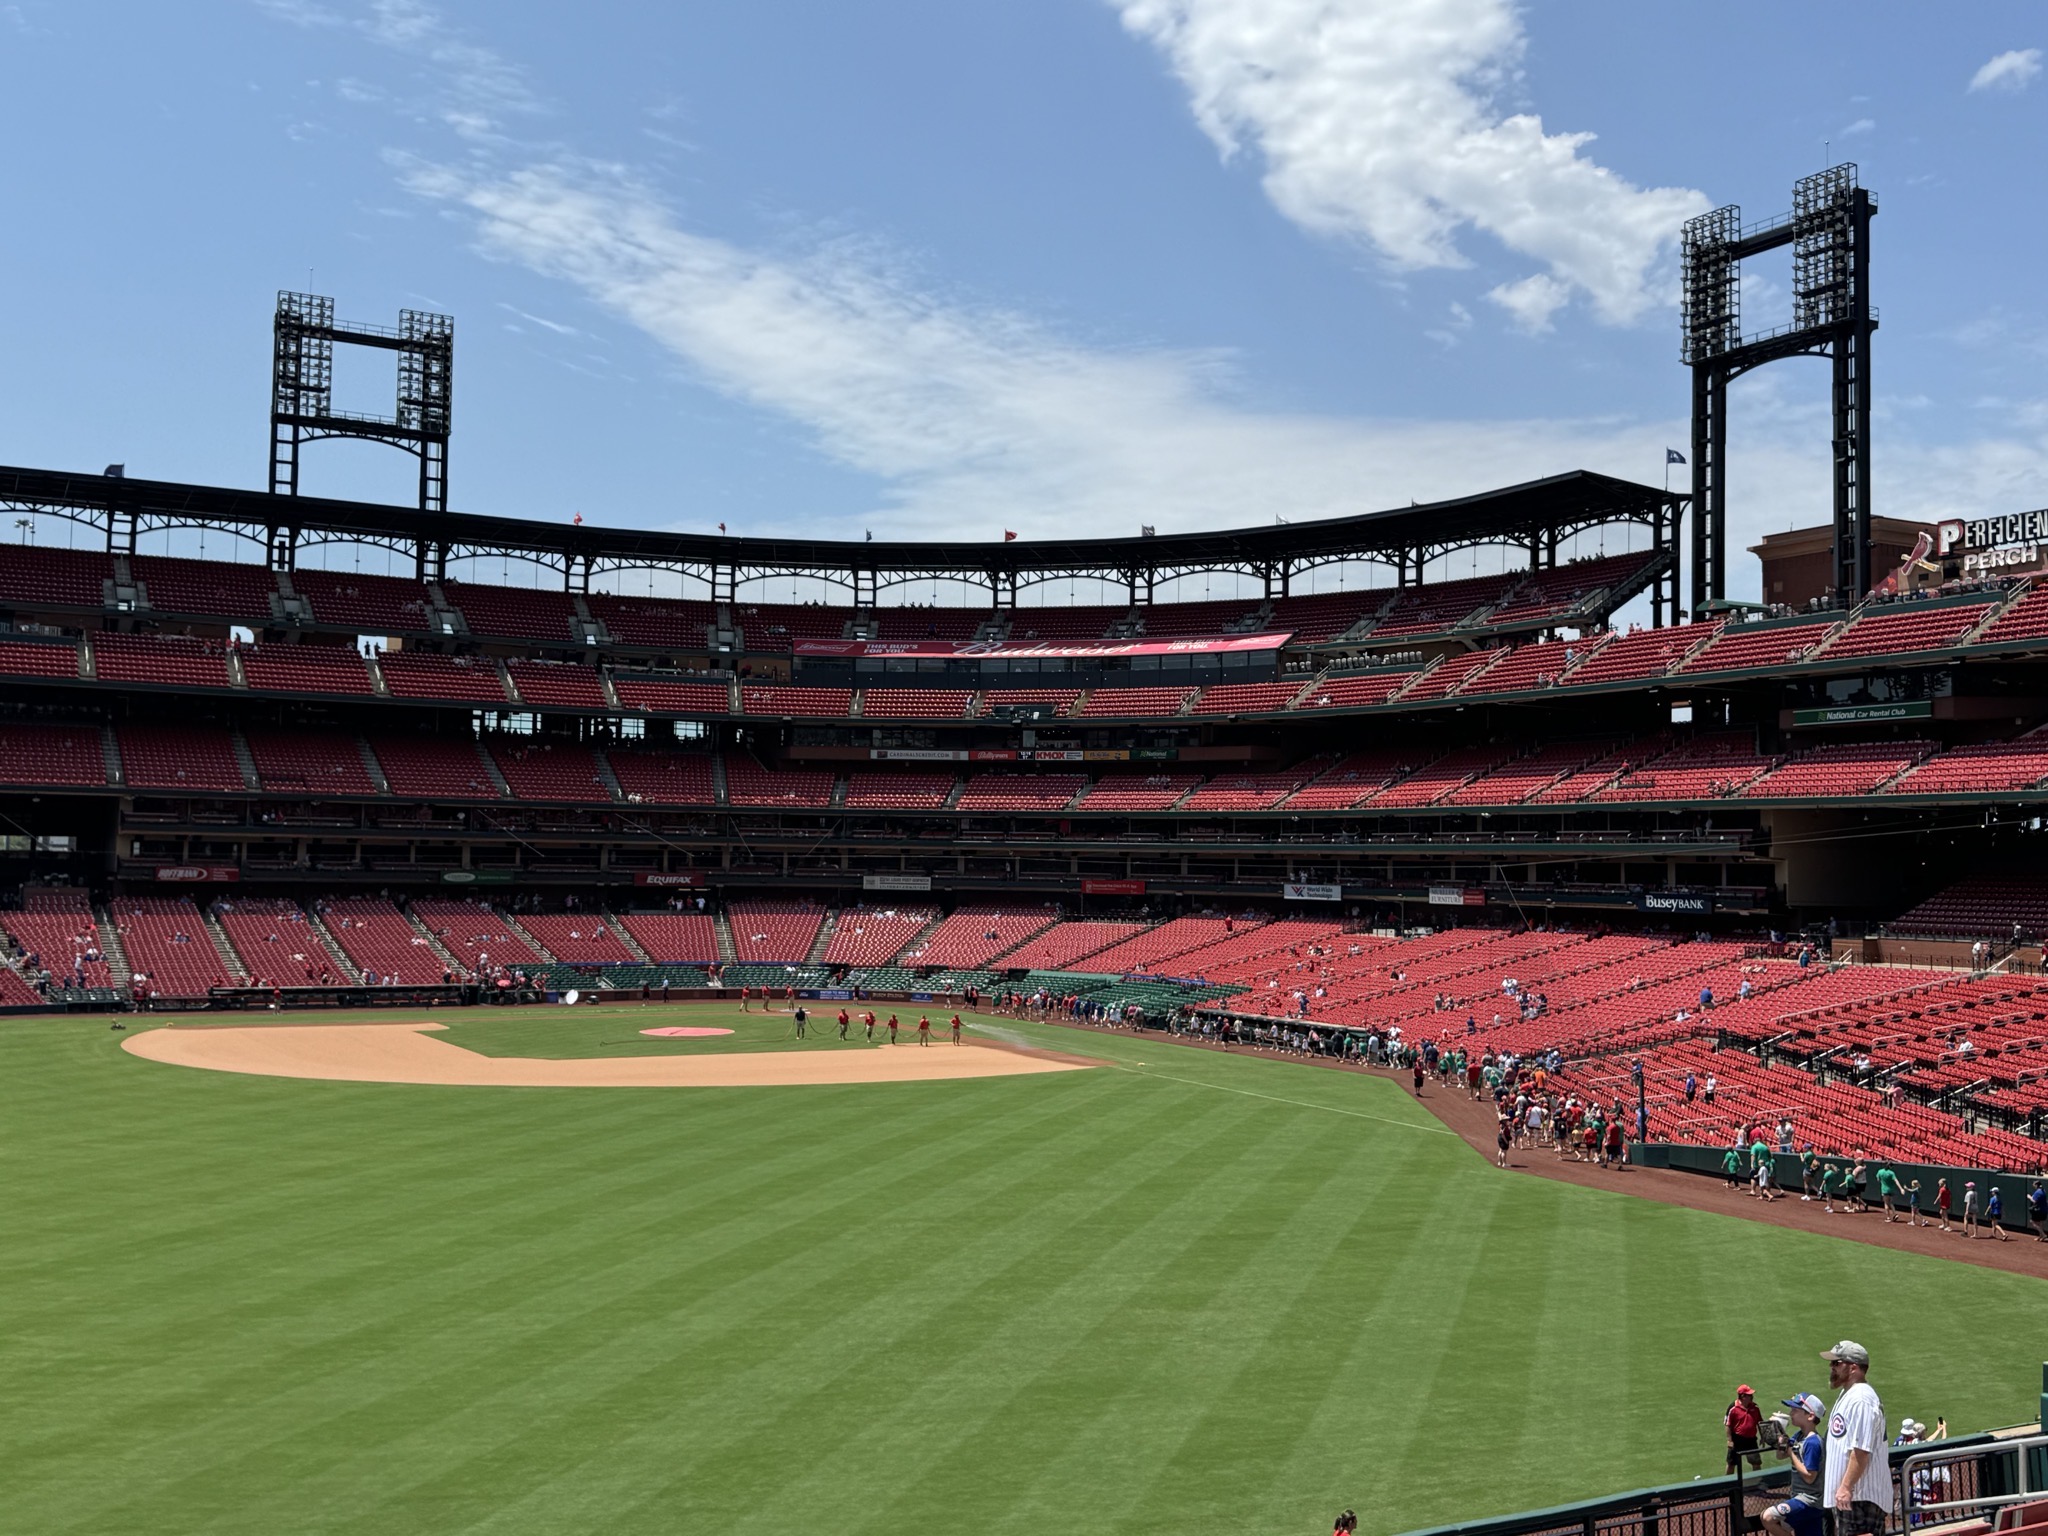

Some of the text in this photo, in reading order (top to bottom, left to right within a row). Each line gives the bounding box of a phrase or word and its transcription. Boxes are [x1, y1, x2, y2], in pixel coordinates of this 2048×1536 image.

[1964, 545, 2038, 572] PERCH
[952, 640, 1144, 657] Budweiser
[1826, 710, 1856, 720] National
[1869, 709, 1890, 717] Rental
[1891, 708, 1906, 716] Club
[1036, 751, 1065, 760] KMOX
[646, 875, 692, 885] EQUIFAX
